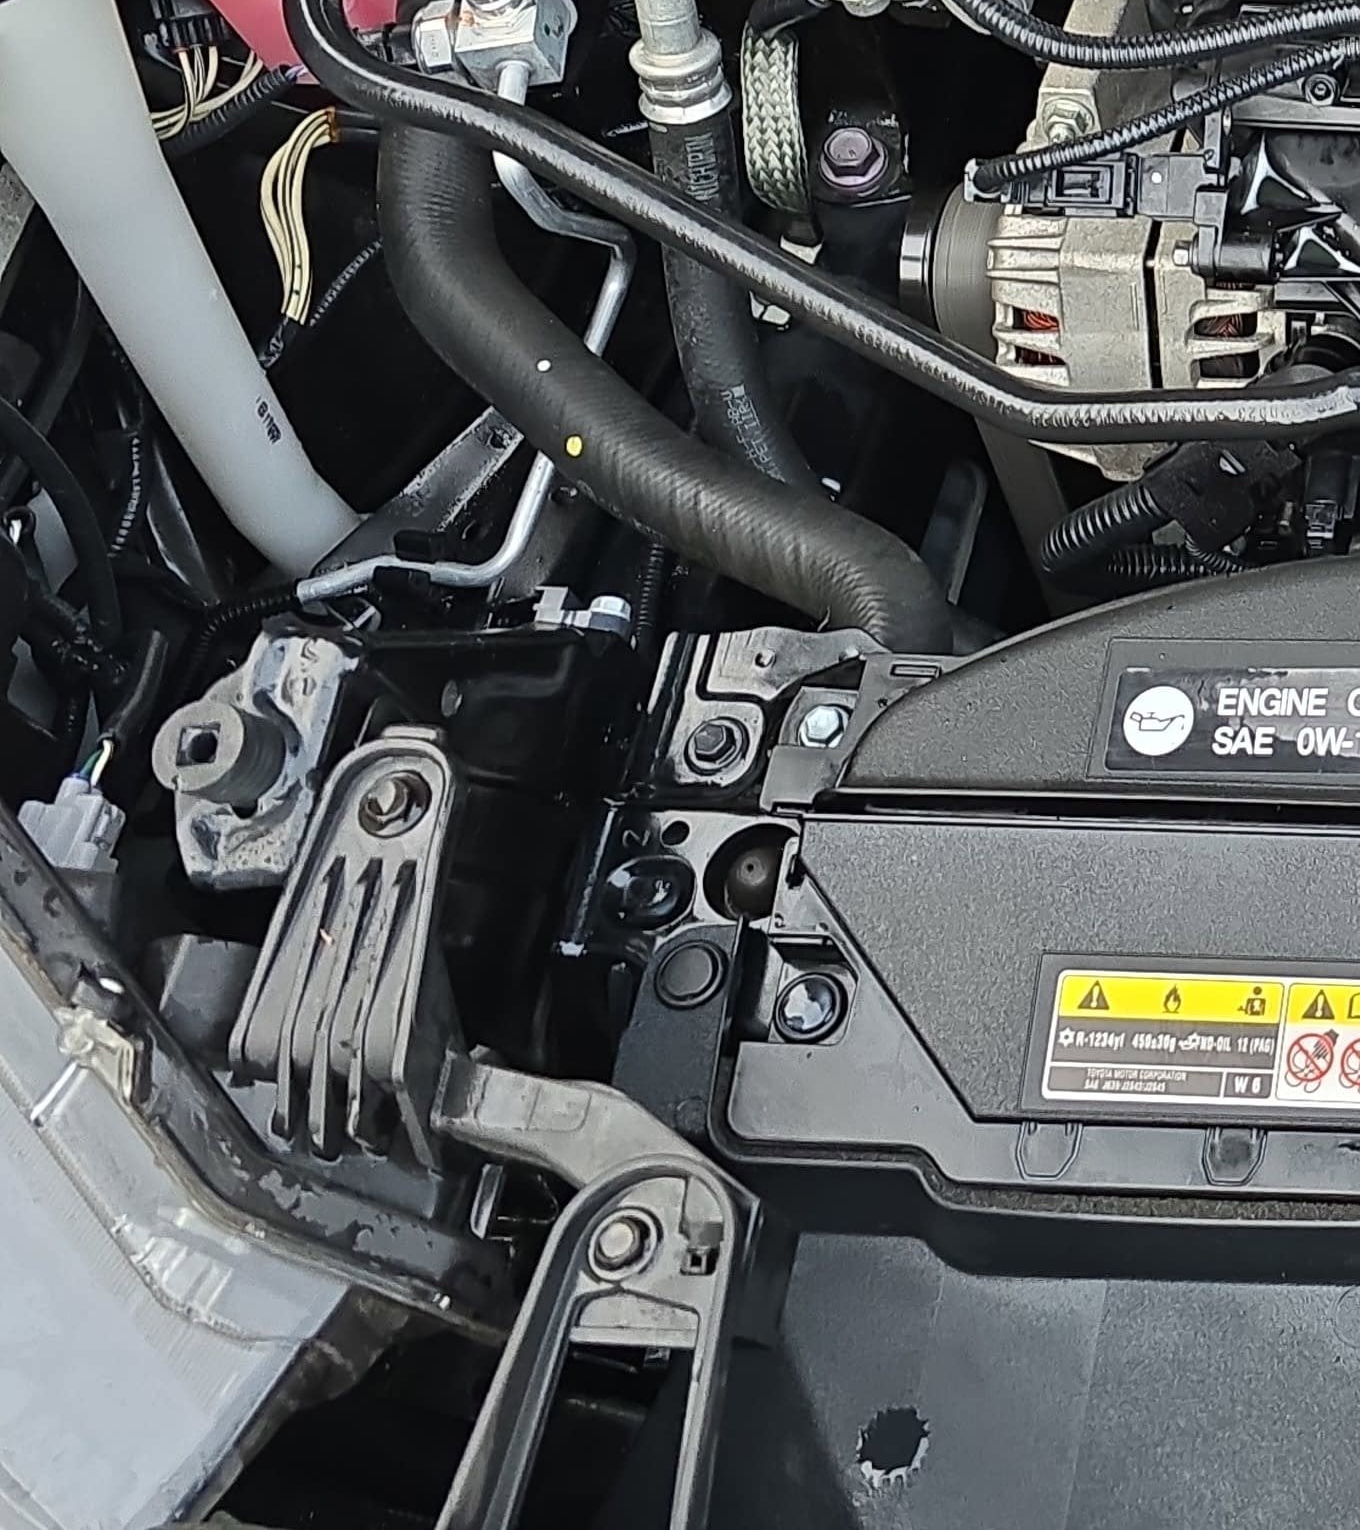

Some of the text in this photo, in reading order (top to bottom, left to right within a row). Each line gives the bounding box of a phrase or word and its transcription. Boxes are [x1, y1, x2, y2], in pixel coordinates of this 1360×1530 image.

[1216, 687, 1329, 717] ENGINE
[1212, 726, 1276, 756] SAE
[1076, 1030, 1126, 1051] R-1234yf
[1237, 1037, 1248, 1053] 12
[1249, 1037, 1275, 1056] (PAG)
[1087, 1068, 1113, 1079] TOYOTA
[1114, 1070, 1138, 1080] MOTOR
[1233, 1076, 1248, 1093] W
